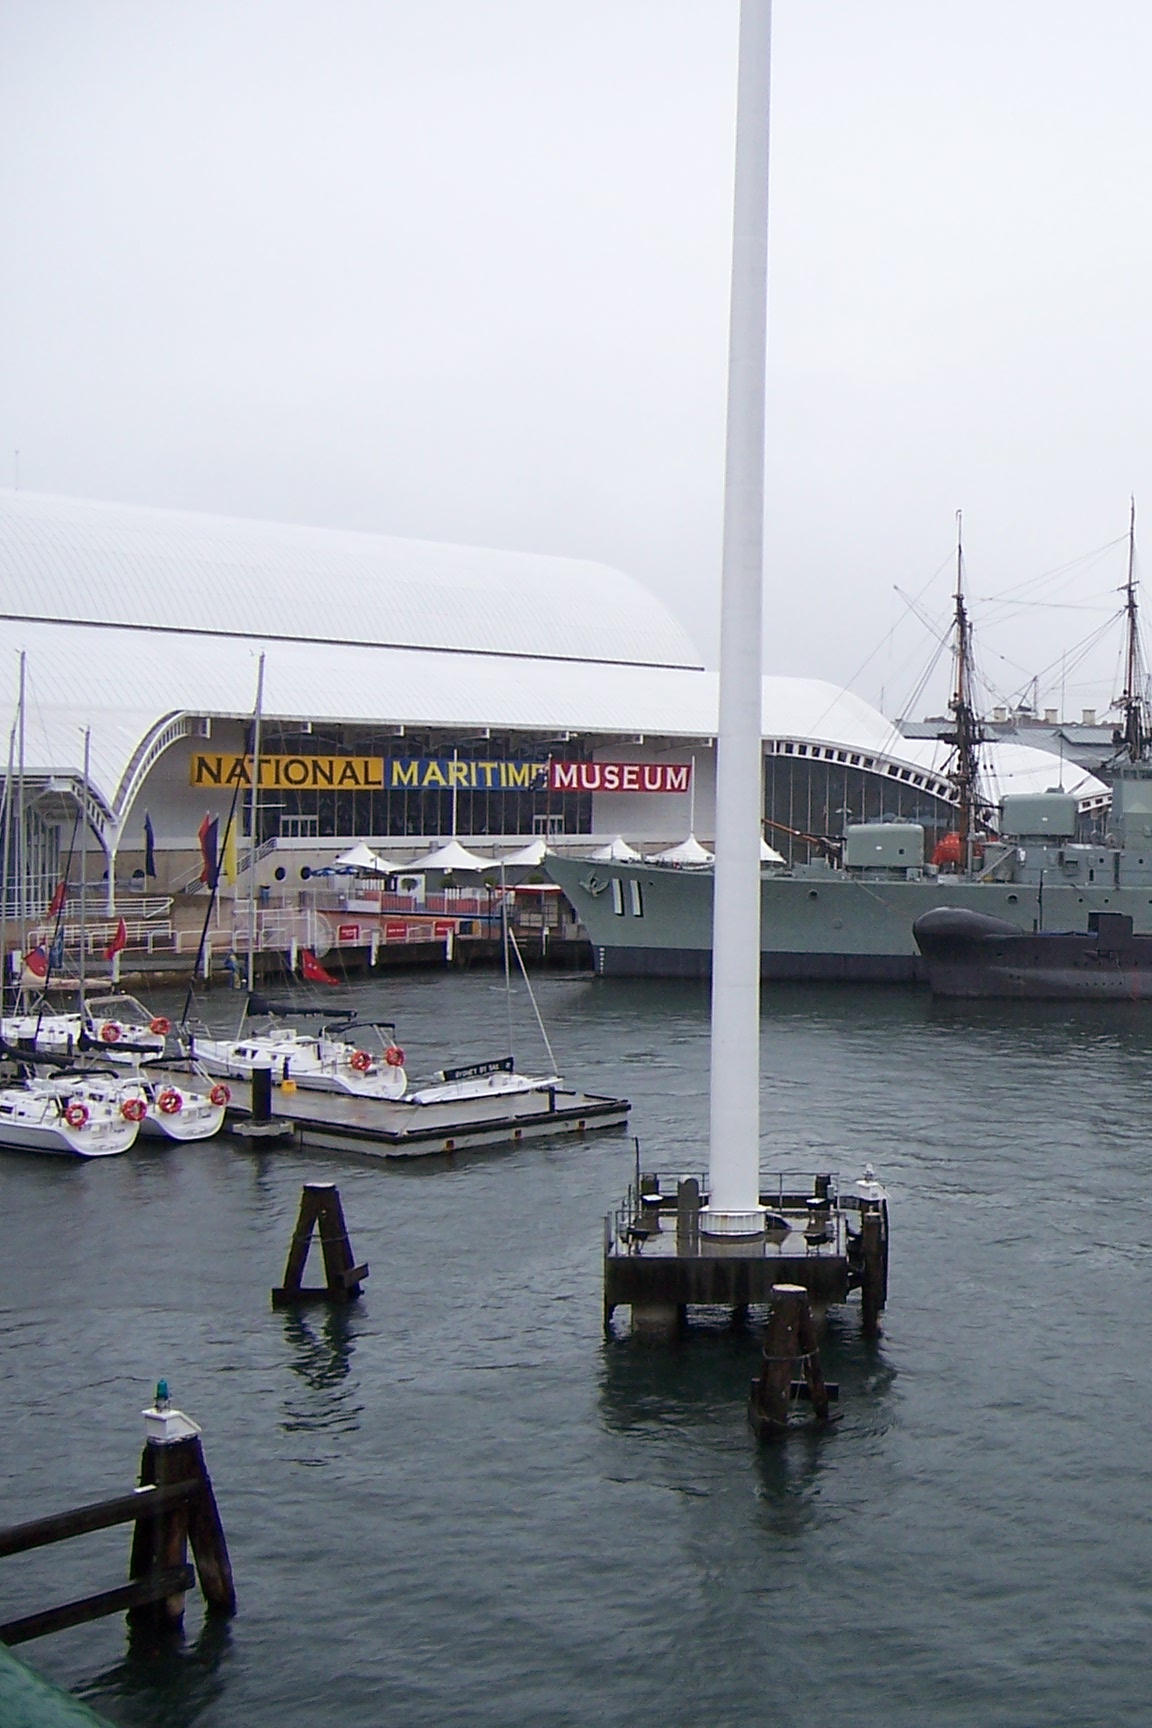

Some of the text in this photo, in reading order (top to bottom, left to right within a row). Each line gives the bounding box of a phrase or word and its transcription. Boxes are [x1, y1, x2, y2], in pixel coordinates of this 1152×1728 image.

[195, 756, 382, 786] NATIONAL
[553, 763, 690, 790] MUSEUM
[612, 878, 643, 917] 11
